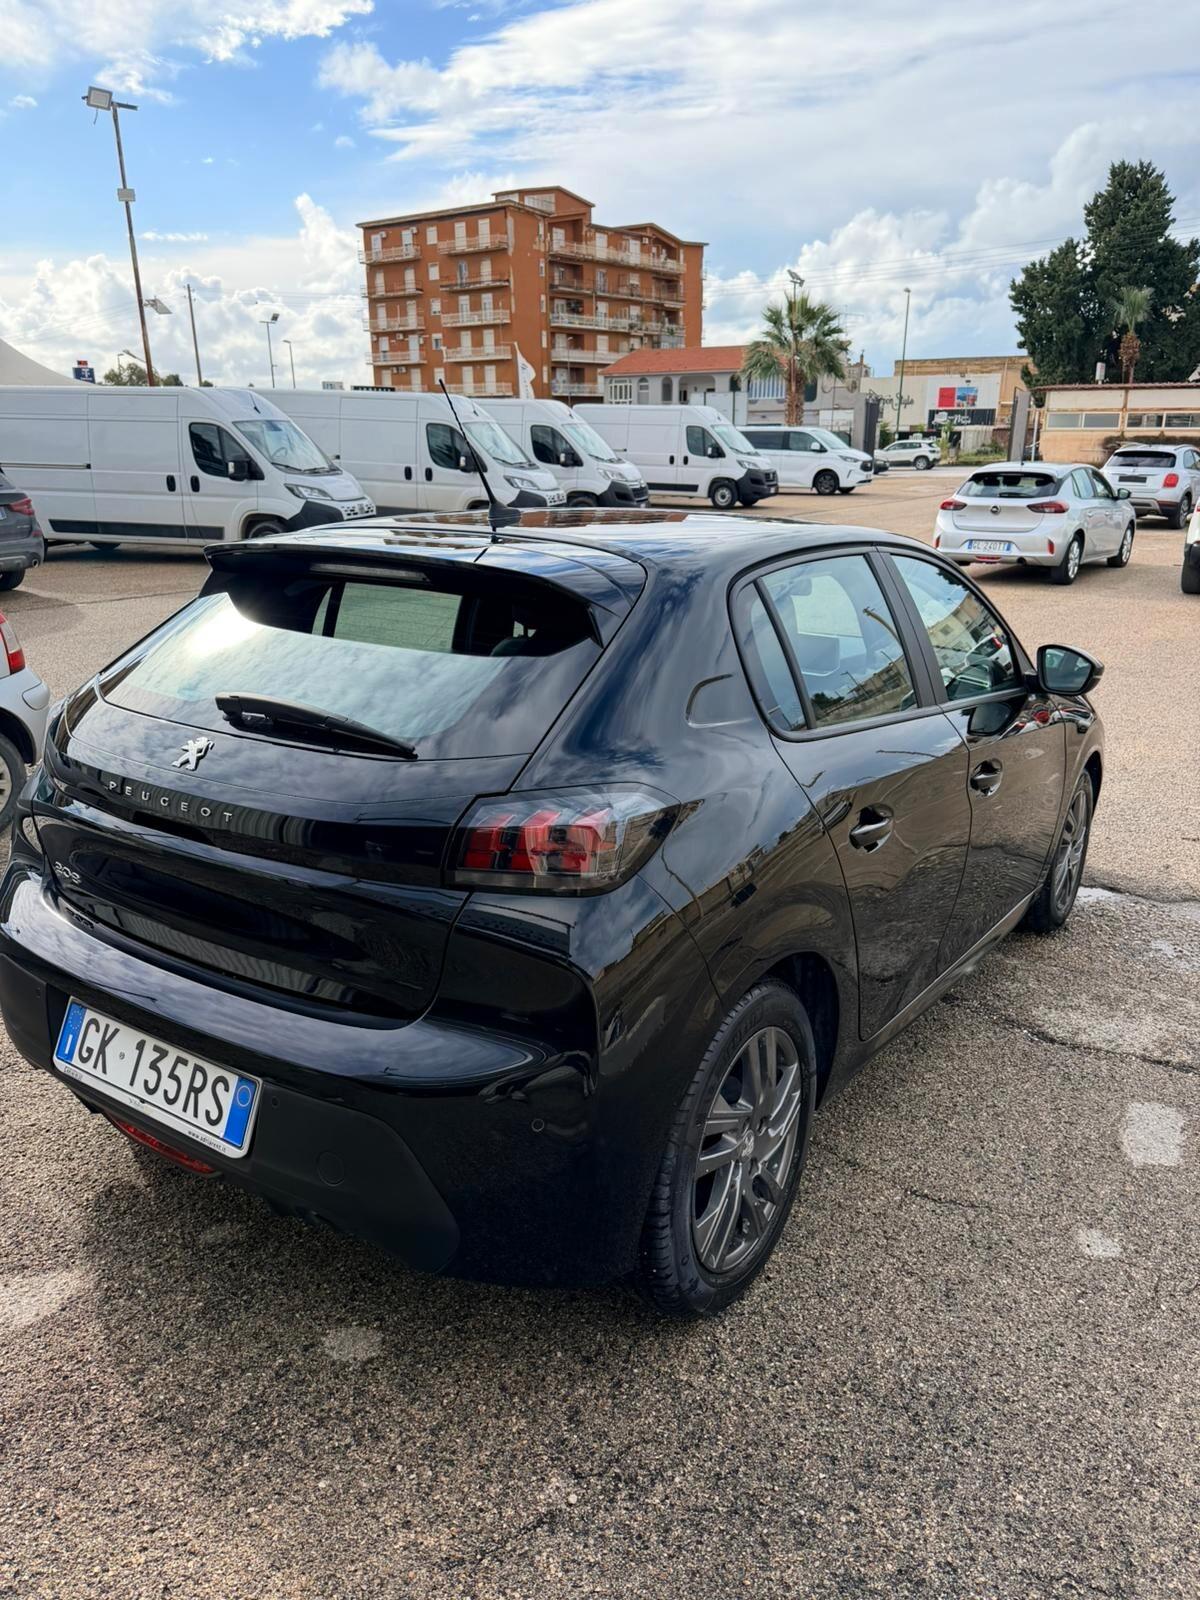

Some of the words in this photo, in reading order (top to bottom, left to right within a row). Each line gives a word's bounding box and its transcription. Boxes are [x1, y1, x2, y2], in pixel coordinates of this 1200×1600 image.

[108, 780, 233, 823] PEUGEOT
[55, 861, 82, 884] 208
[78, 1017, 120, 1075] GK
[129, 1038, 230, 1126] 135RS
